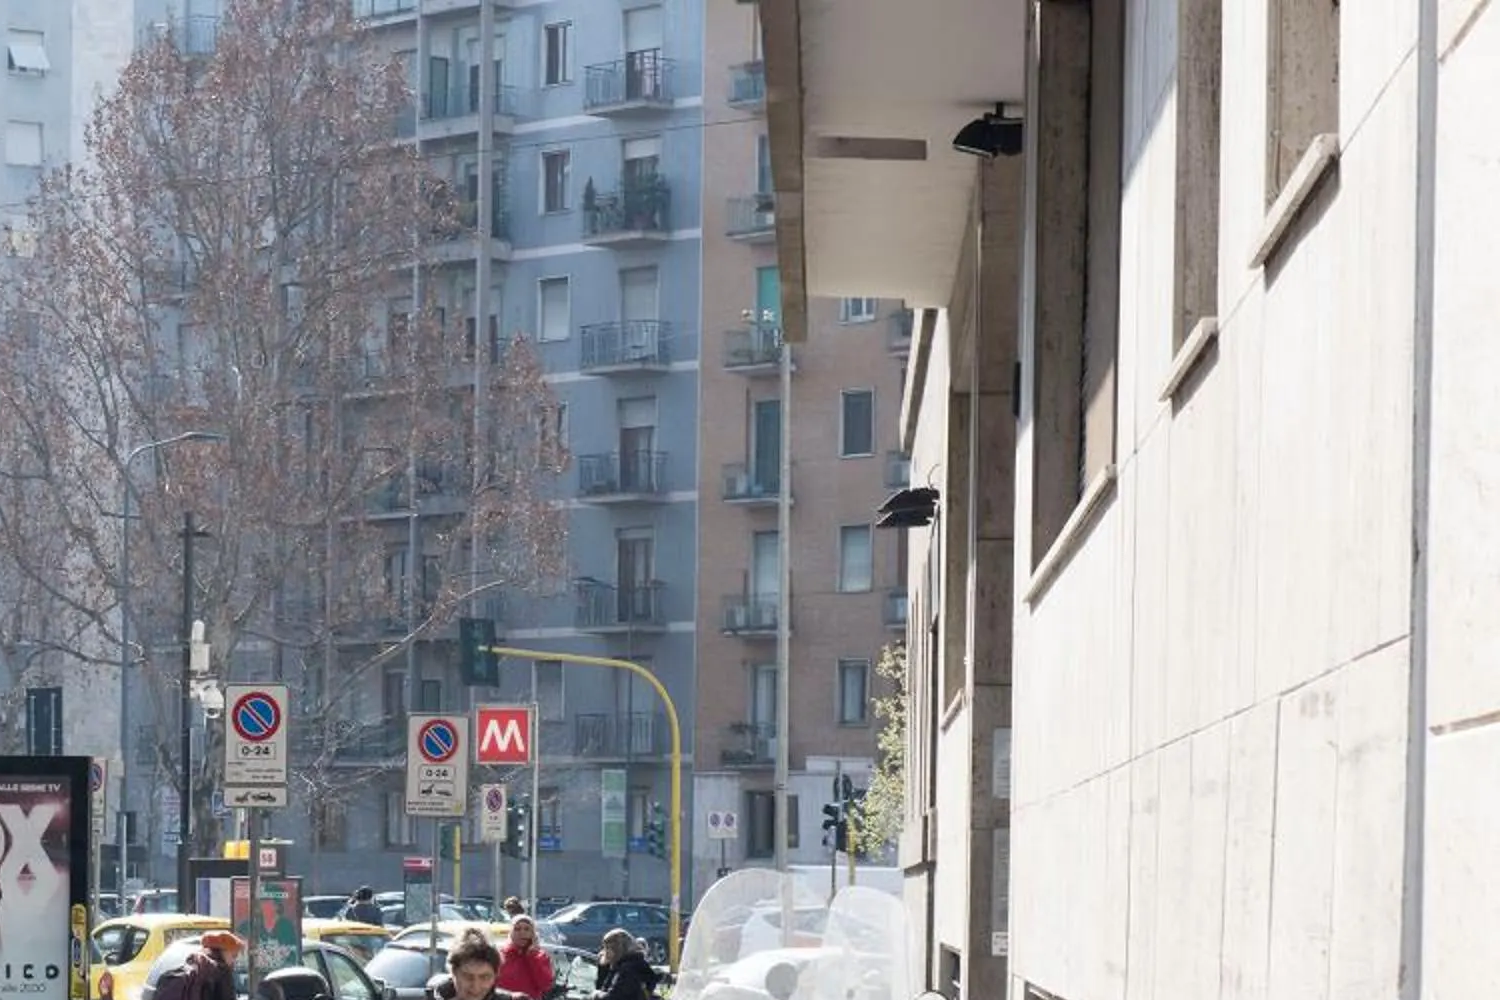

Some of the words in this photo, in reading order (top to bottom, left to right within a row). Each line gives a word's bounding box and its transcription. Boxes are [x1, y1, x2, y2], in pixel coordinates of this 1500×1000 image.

[480, 719, 525, 752] M
[241, 745, 270, 756] 0-24
[425, 769, 449, 777] 0-24
[48, 784, 61, 792] TV
